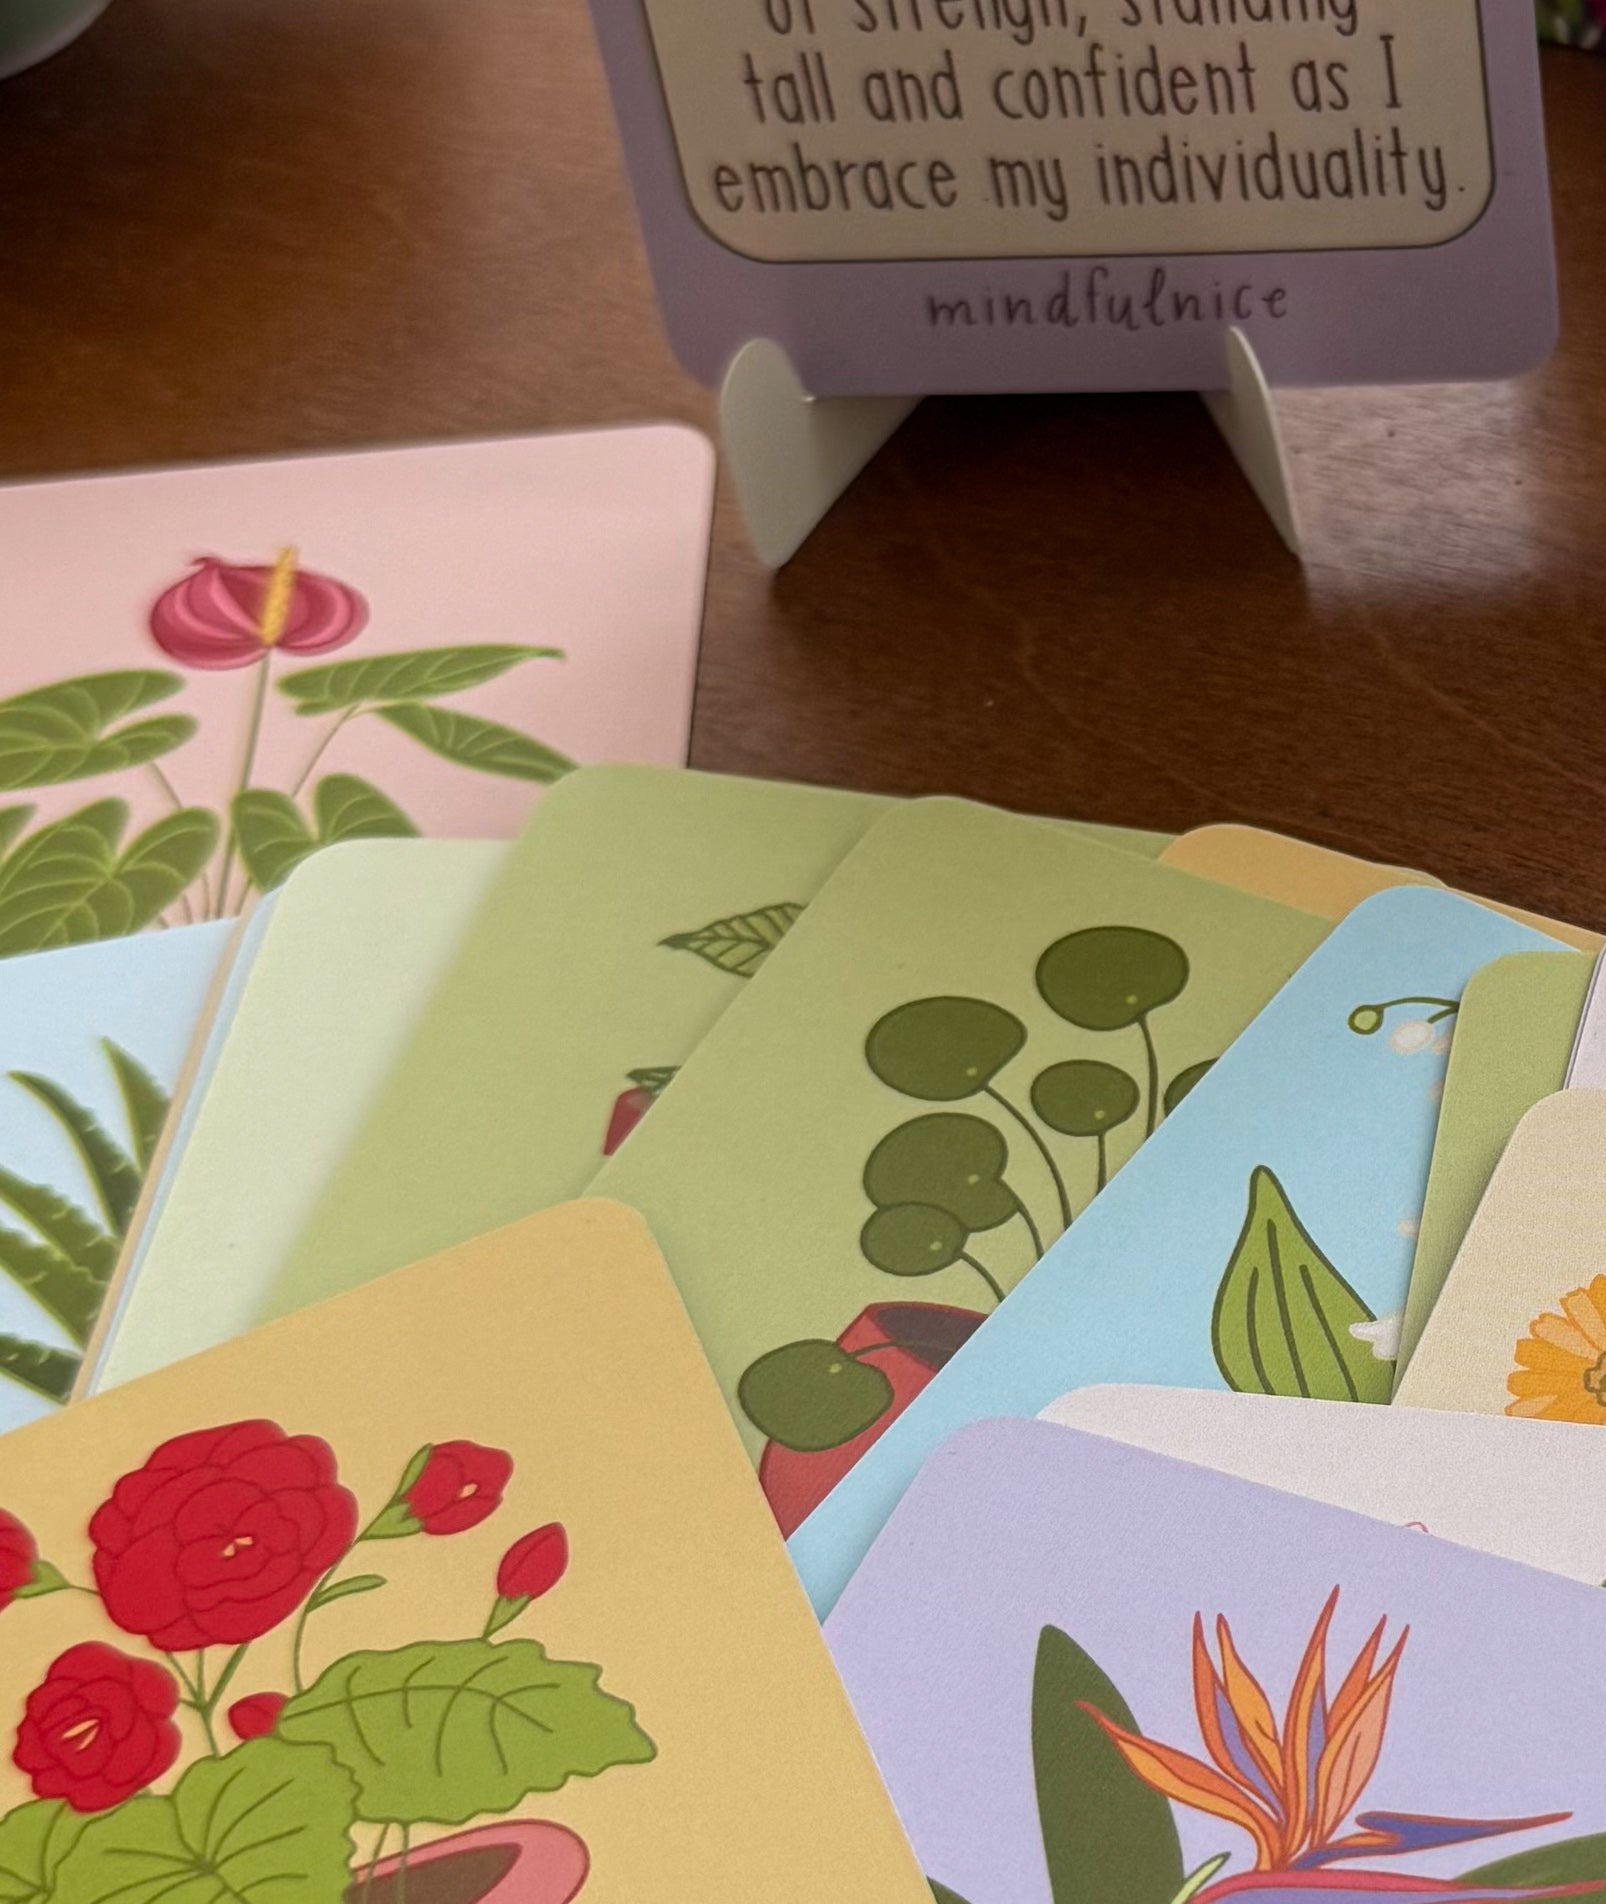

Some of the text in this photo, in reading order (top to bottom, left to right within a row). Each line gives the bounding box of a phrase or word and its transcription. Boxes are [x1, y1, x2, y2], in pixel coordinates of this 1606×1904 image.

[742, 34, 1405, 126] tall and confident as I
[713, 124, 1468, 223] embrace my individuality.
[924, 265, 1290, 332] mindfulnice
